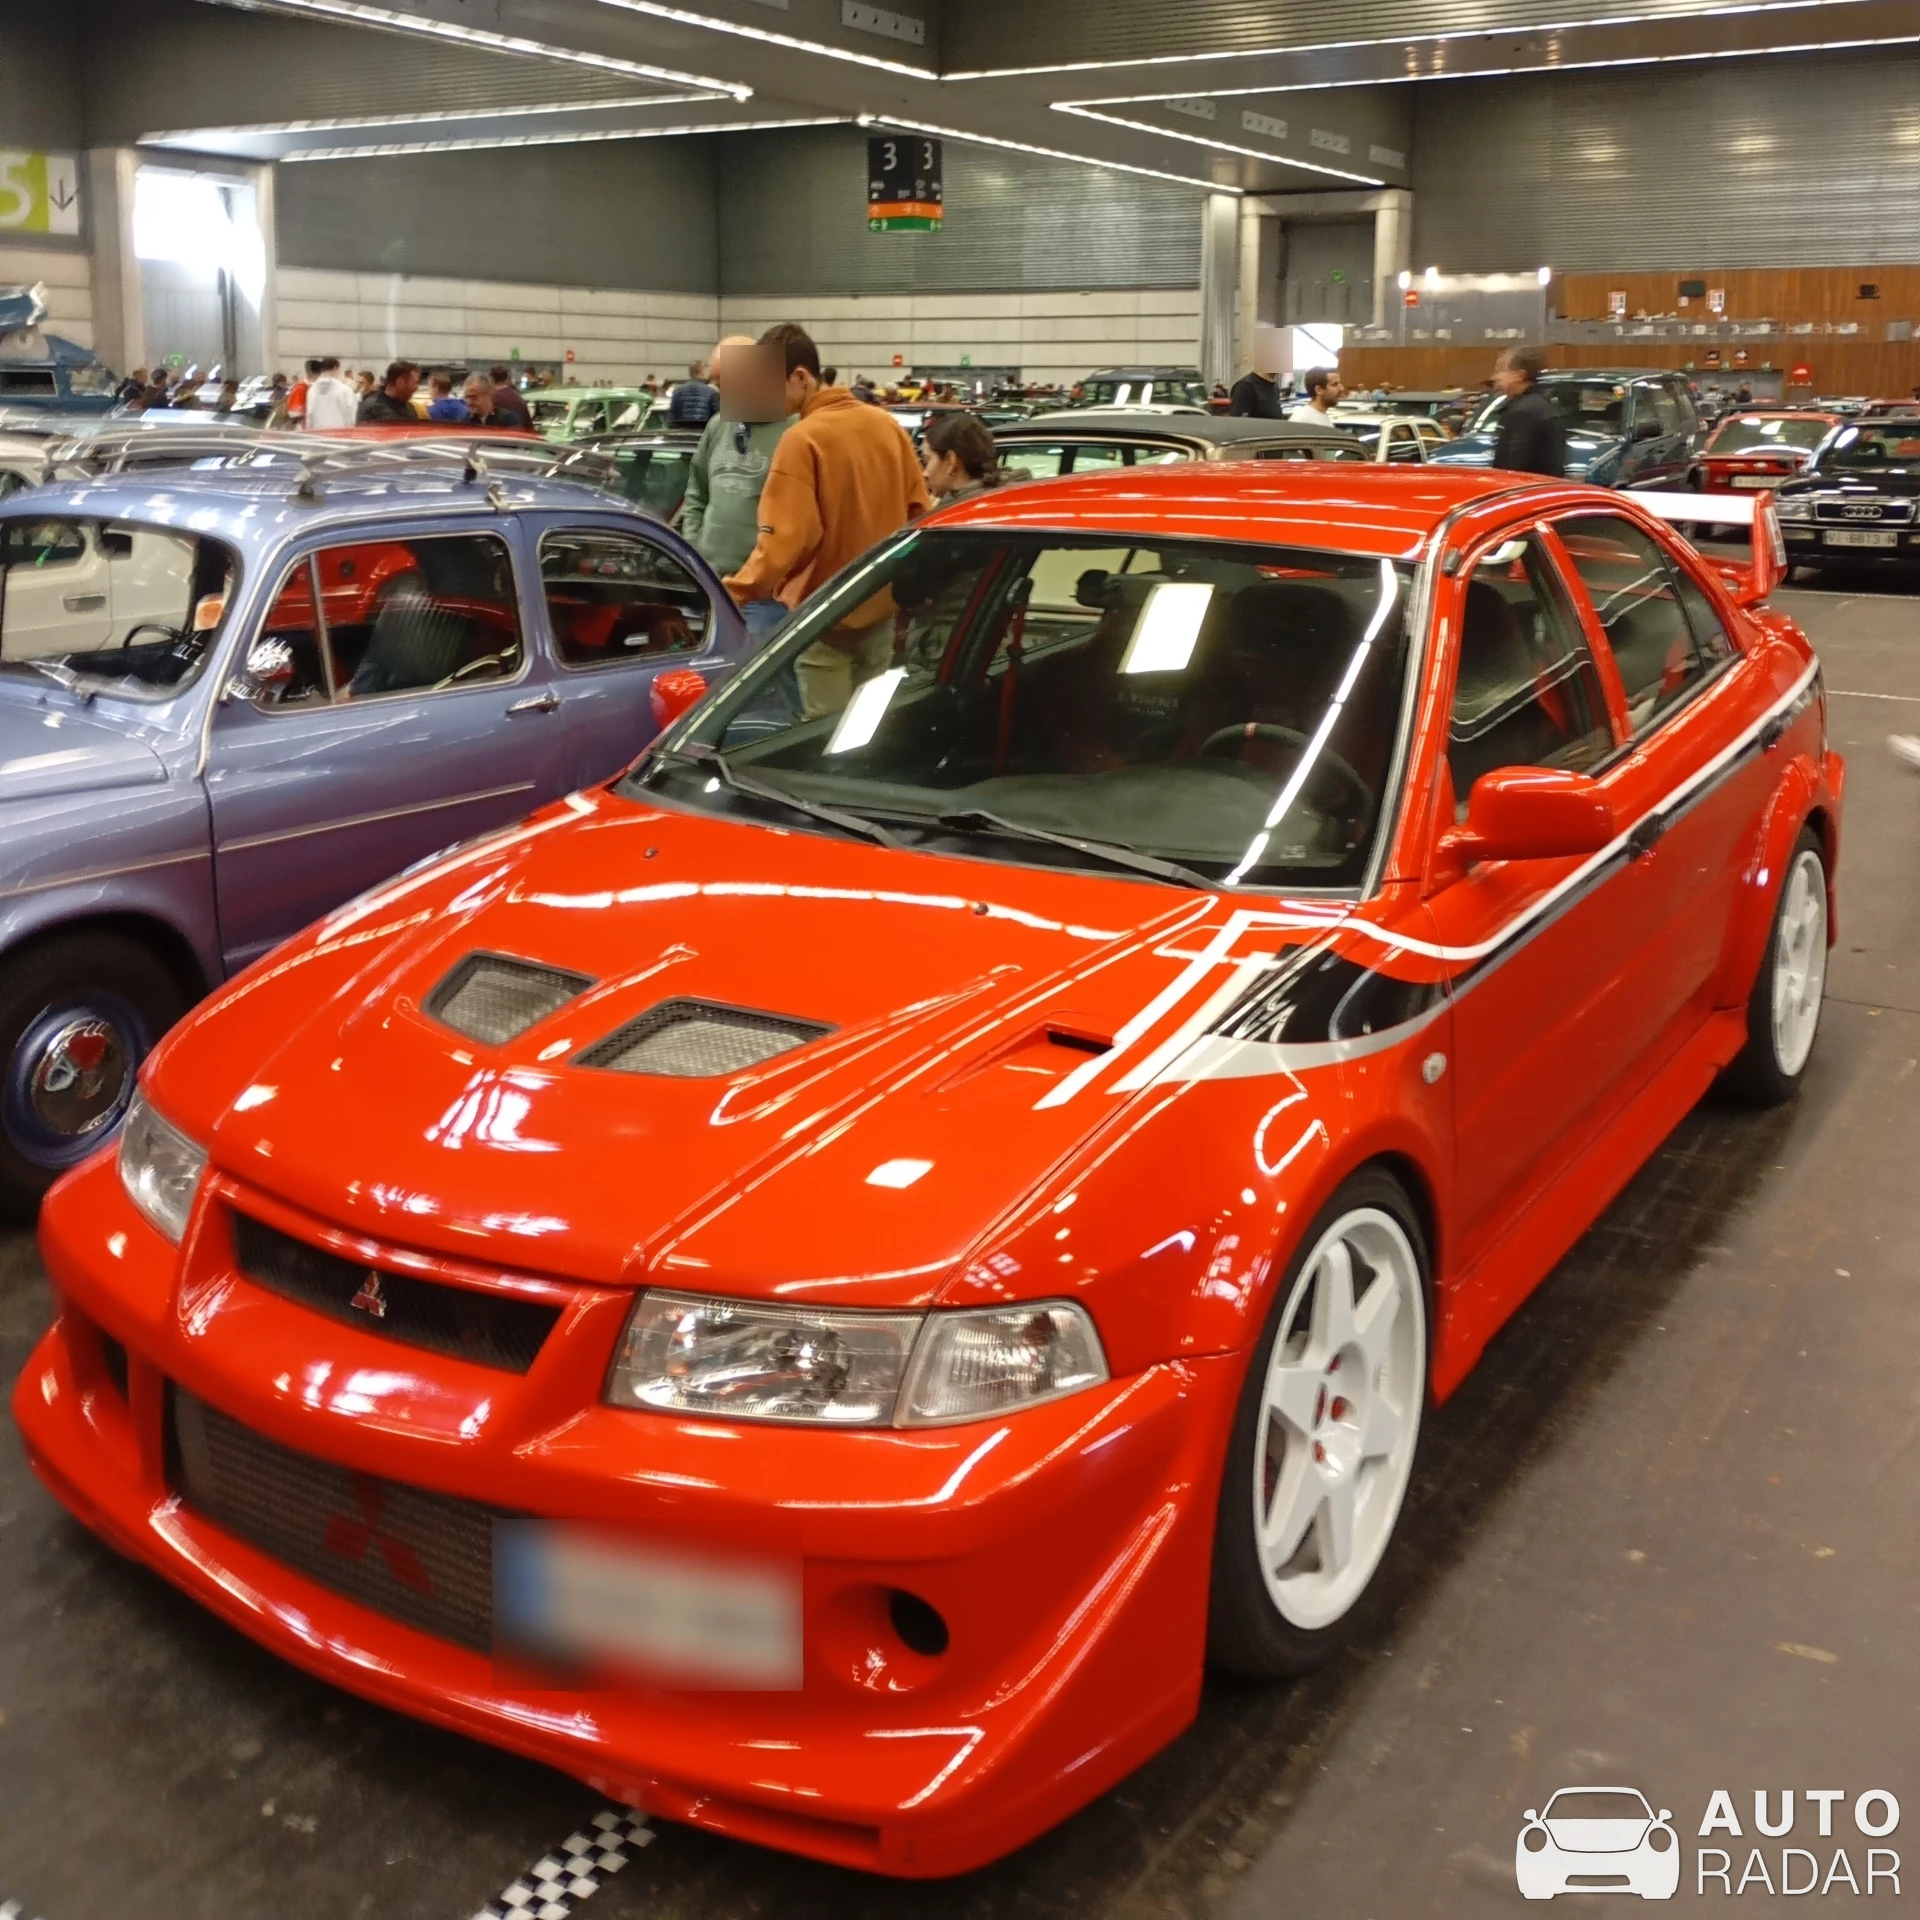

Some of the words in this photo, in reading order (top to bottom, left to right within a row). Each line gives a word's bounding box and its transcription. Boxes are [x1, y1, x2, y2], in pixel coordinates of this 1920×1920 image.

[882, 141, 898, 171] 3
[922, 140, 934, 170] 3
[0, 152, 33, 227] 5
